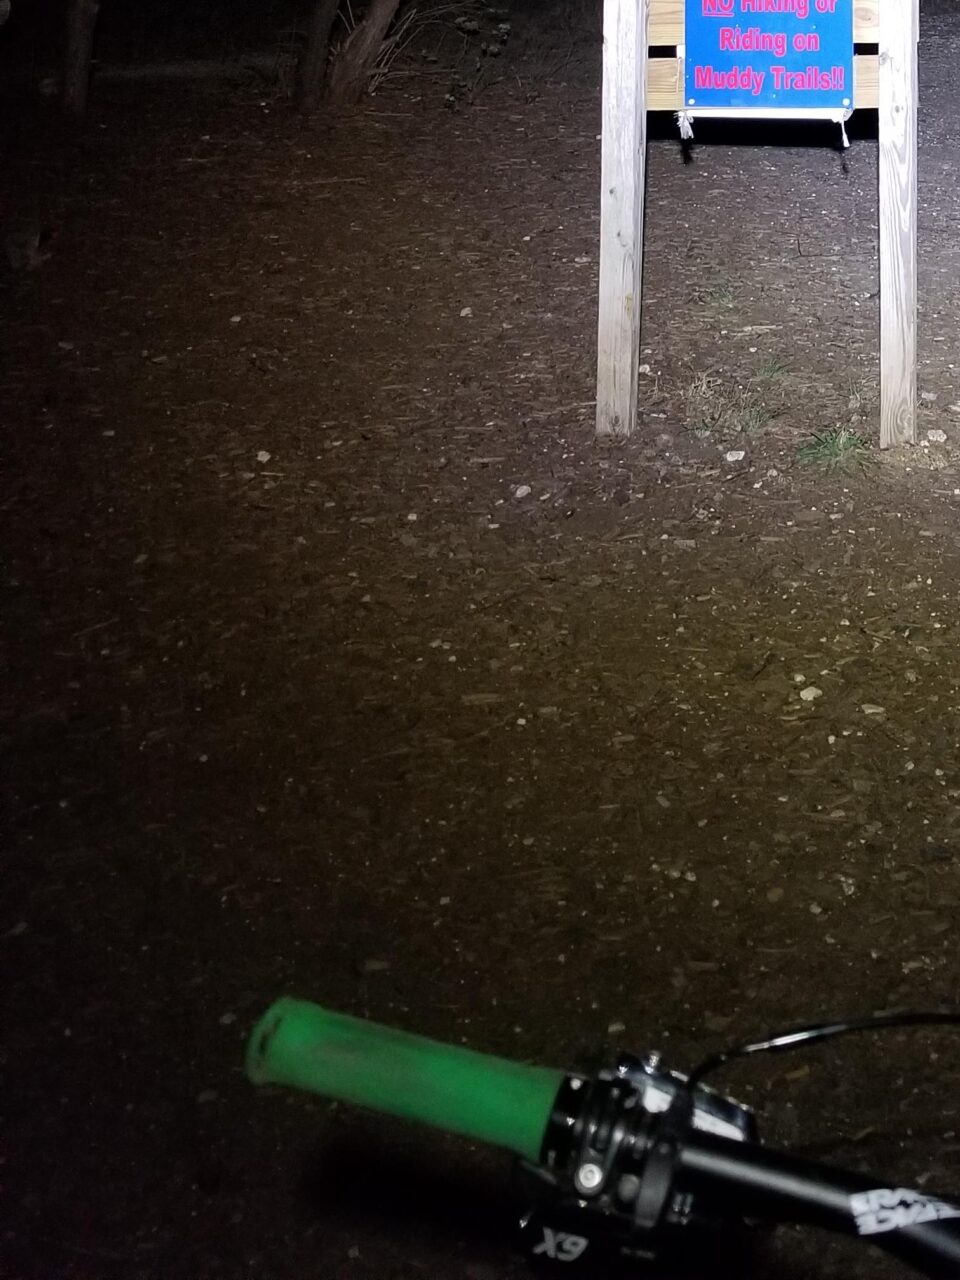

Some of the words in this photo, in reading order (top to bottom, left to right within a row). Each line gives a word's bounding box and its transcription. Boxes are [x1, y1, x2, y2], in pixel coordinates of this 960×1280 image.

[719, 27, 787, 57] Riding
[793, 34, 820, 51] on
[694, 66, 765, 95] Muddy
[771, 66, 845, 90] Trails!!
